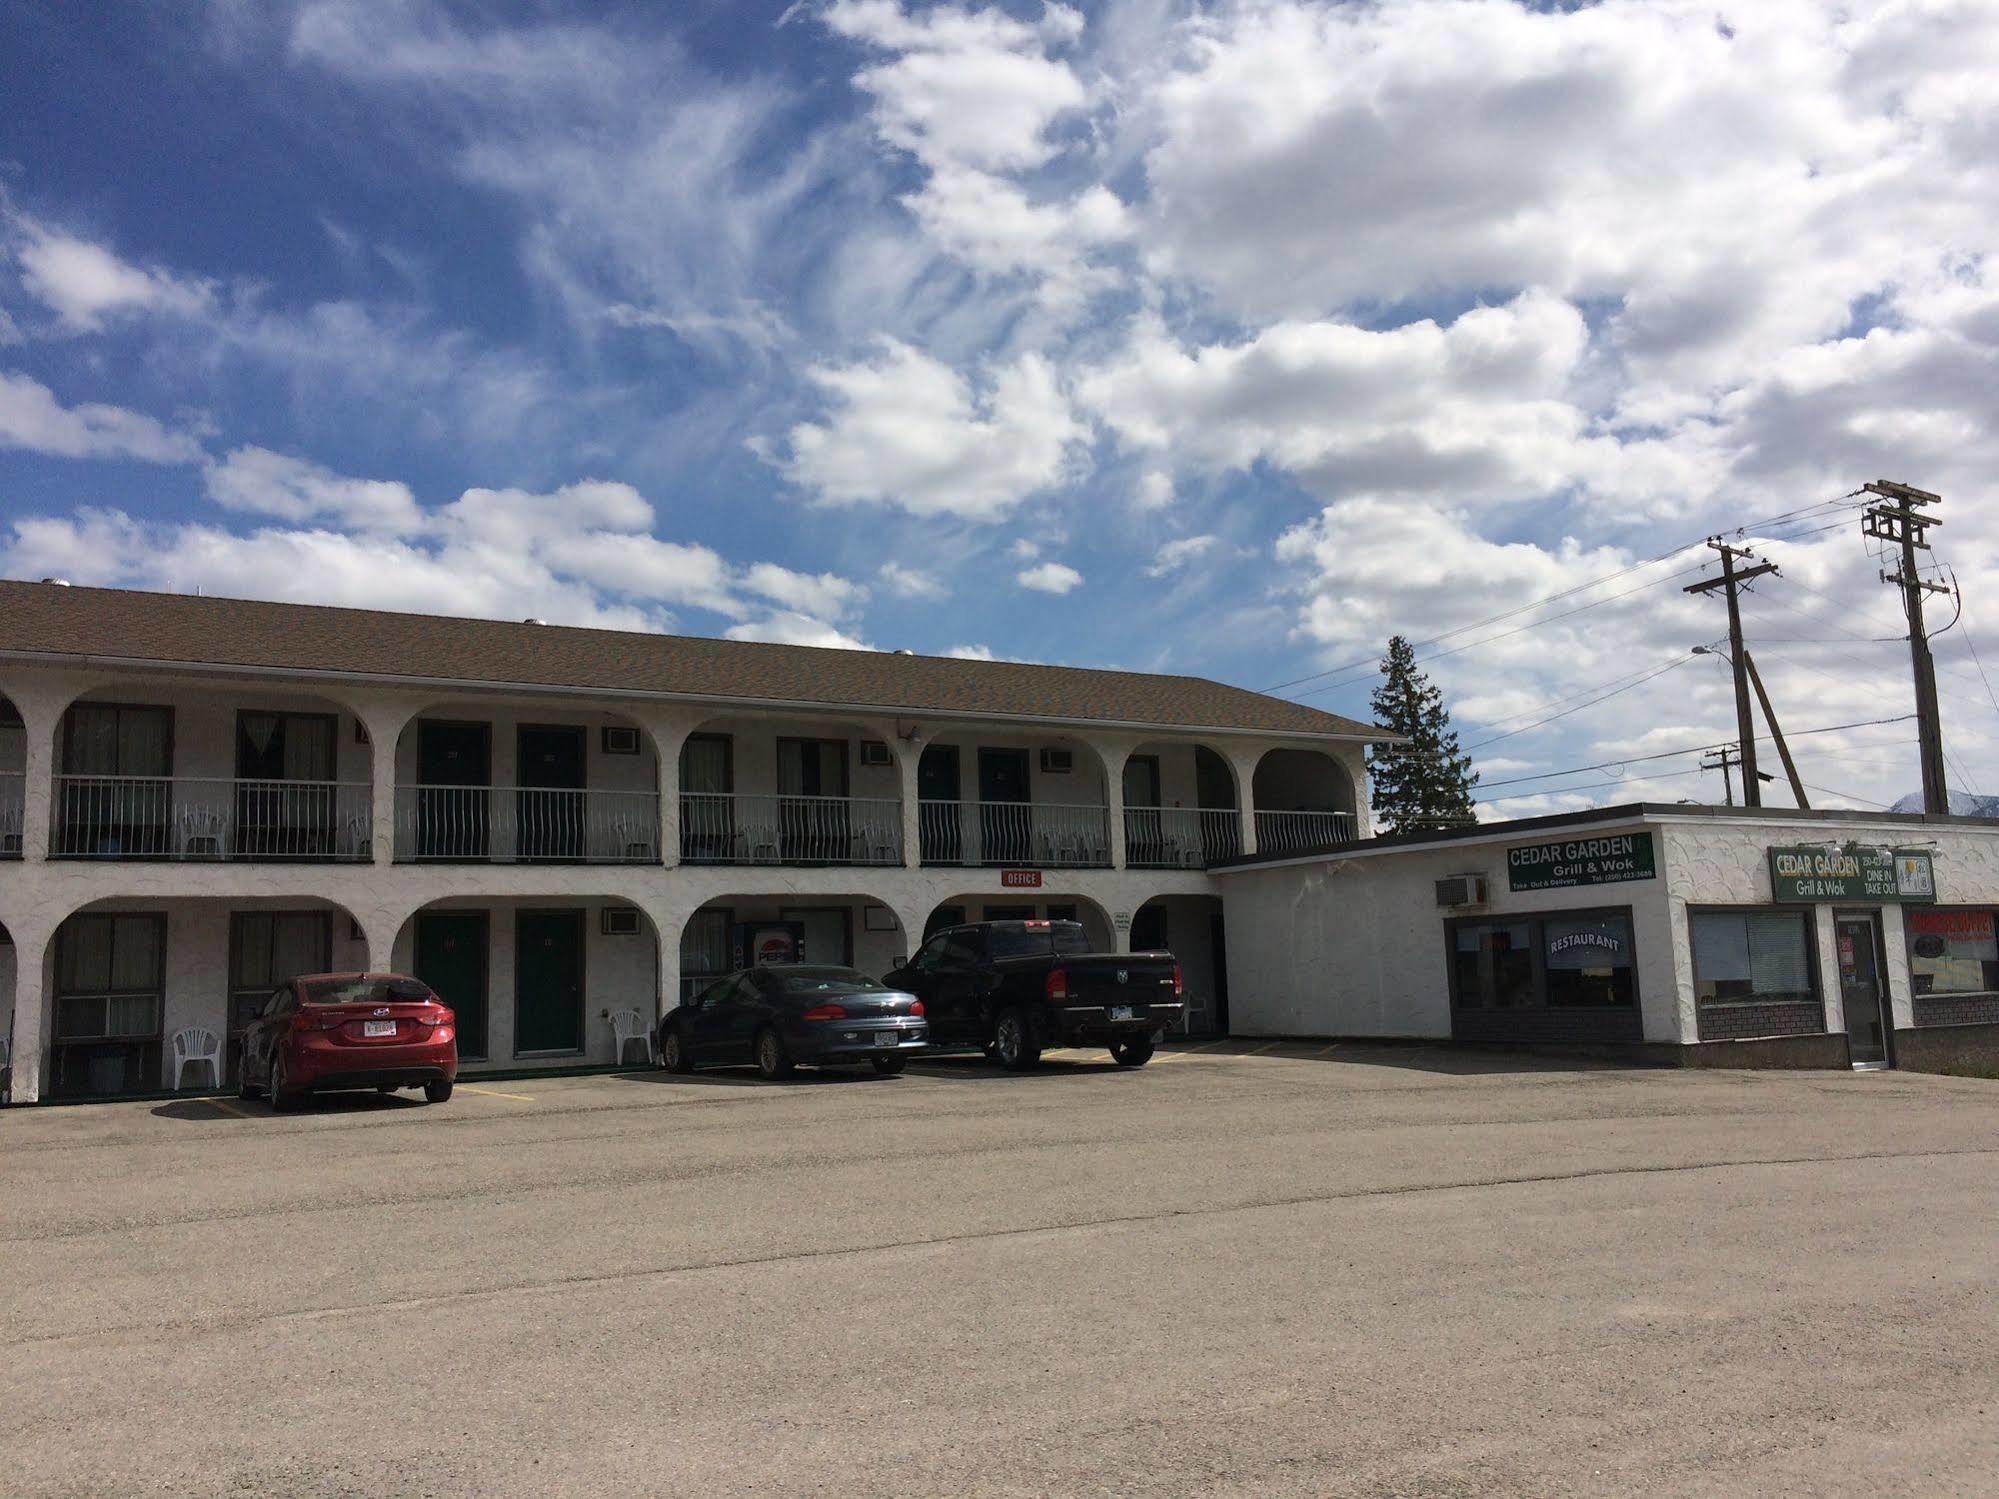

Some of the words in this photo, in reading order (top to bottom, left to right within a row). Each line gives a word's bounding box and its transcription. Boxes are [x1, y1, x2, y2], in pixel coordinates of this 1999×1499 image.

[1510, 845, 1562, 866] CEDAR
[1566, 836, 1633, 860] GARDEN
[1553, 863, 1582, 877] Grill
[1586, 862, 1598, 873] &
[1601, 858, 1634, 872] Wok
[1776, 854, 1812, 875] CEDAR
[1814, 854, 1860, 876] GARDEN
[1007, 872, 1037, 885] OFFICE
[1530, 880, 1543, 889] Out
[1549, 878, 1577, 887] Delivery
[1866, 870, 1883, 882] DINE
[1884, 869, 1892, 881] IN
[1796, 880, 1815, 896] Grill
[1816, 882, 1825, 896] &
[1825, 881, 1846, 896] Wok
[1864, 882, 1882, 895] TAKE
[1882, 882, 1897, 895] OUT
[1550, 932, 1619, 954] RESTAURANT
